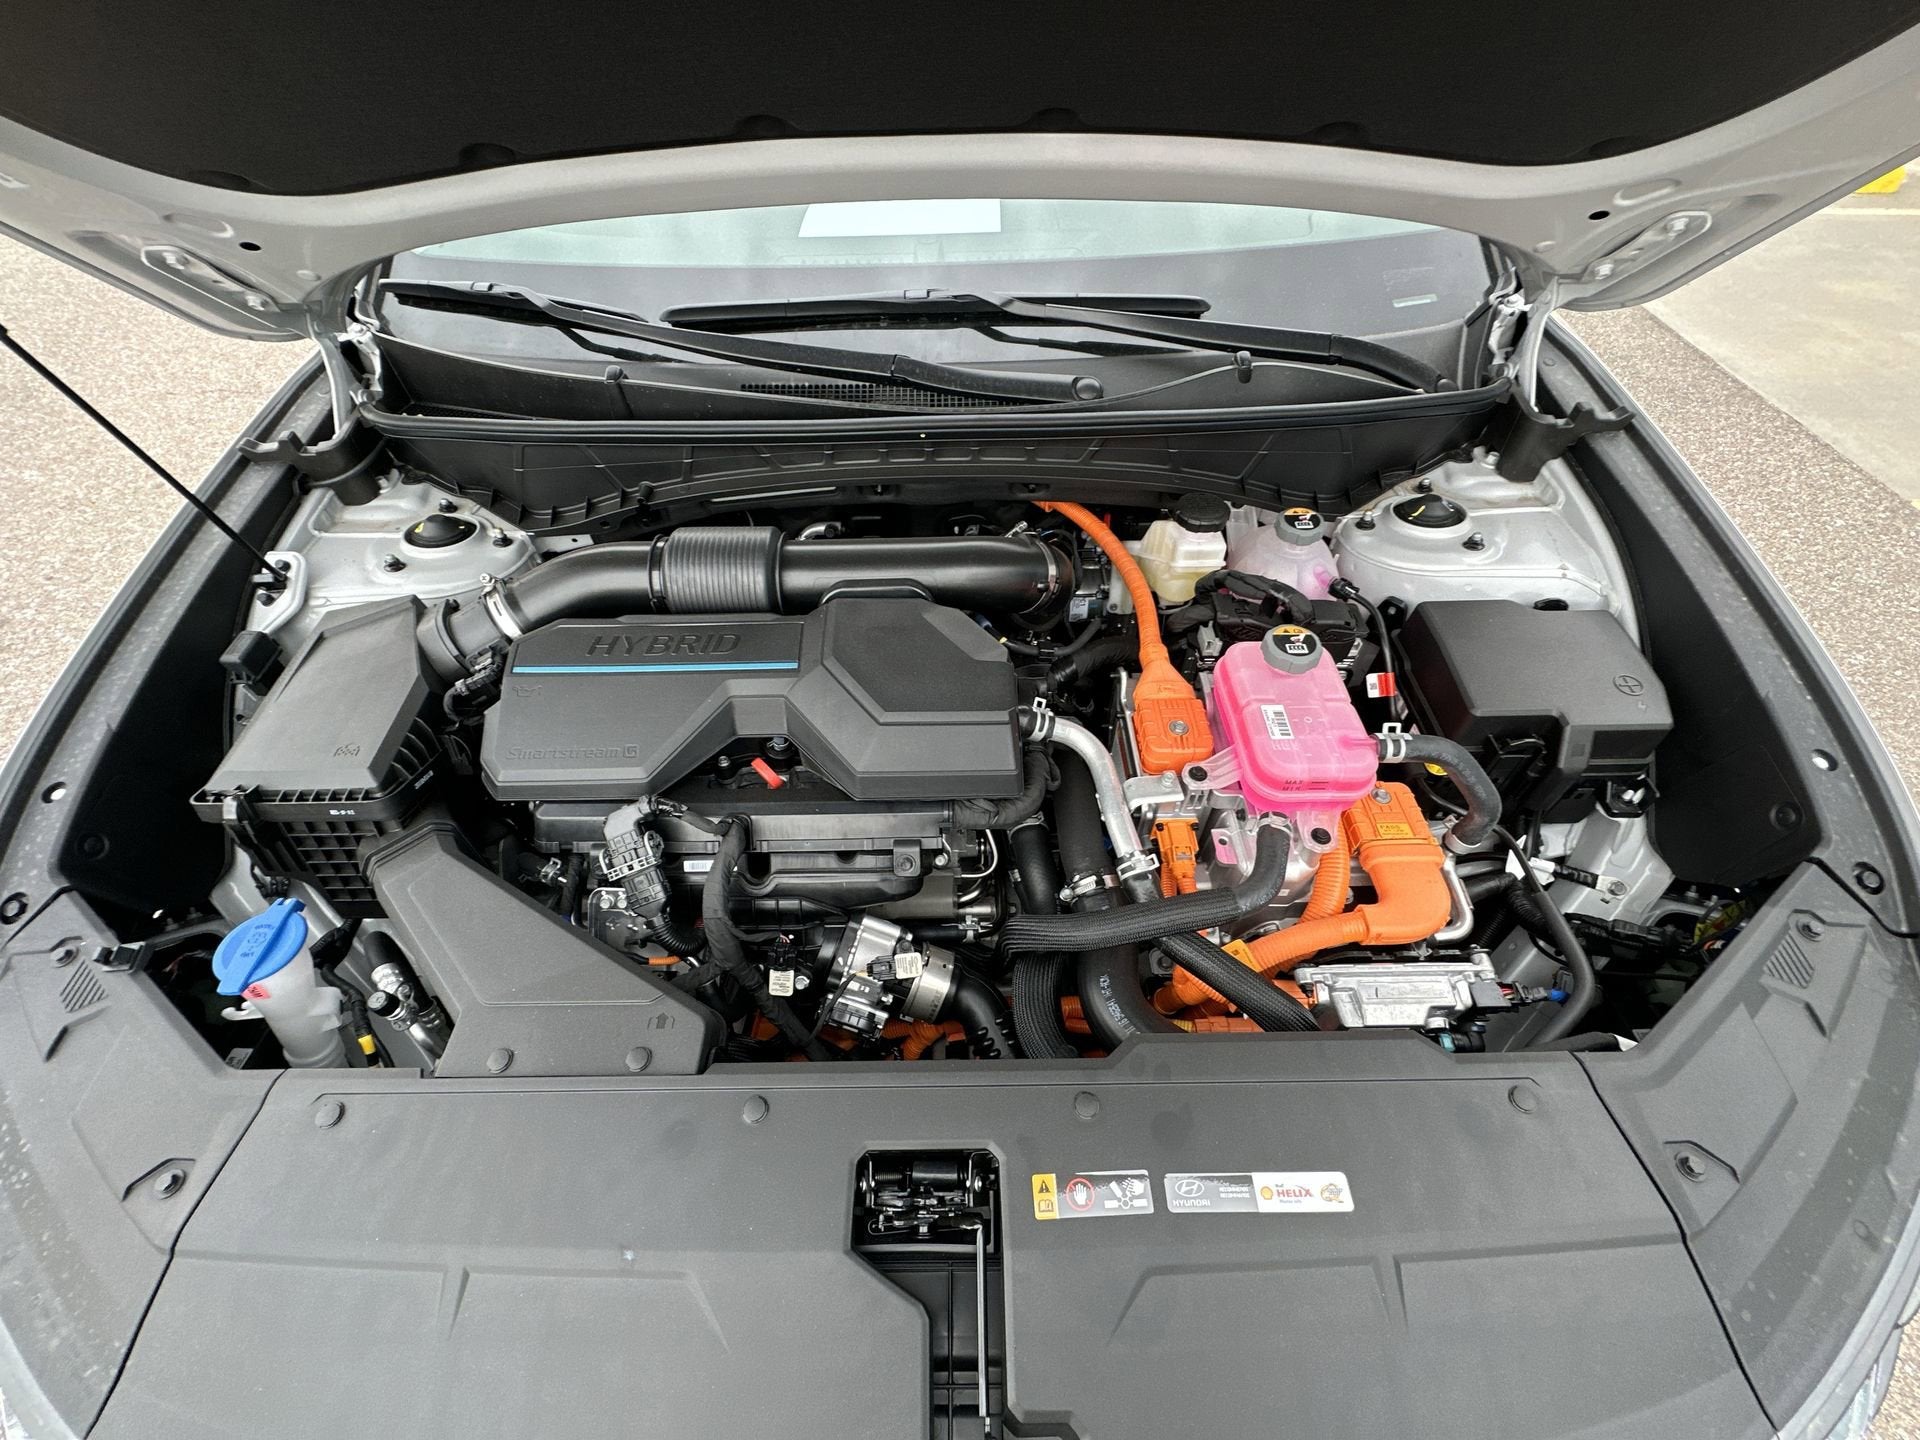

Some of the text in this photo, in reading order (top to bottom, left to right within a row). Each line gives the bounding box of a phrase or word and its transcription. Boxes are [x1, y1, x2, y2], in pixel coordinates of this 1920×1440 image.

[585, 633, 741, 657] HYBRID
[505, 745, 620, 760] Smartstream
[1276, 1188, 1313, 1198] HELIX
[1172, 1199, 1212, 1208] HYUNDAI
